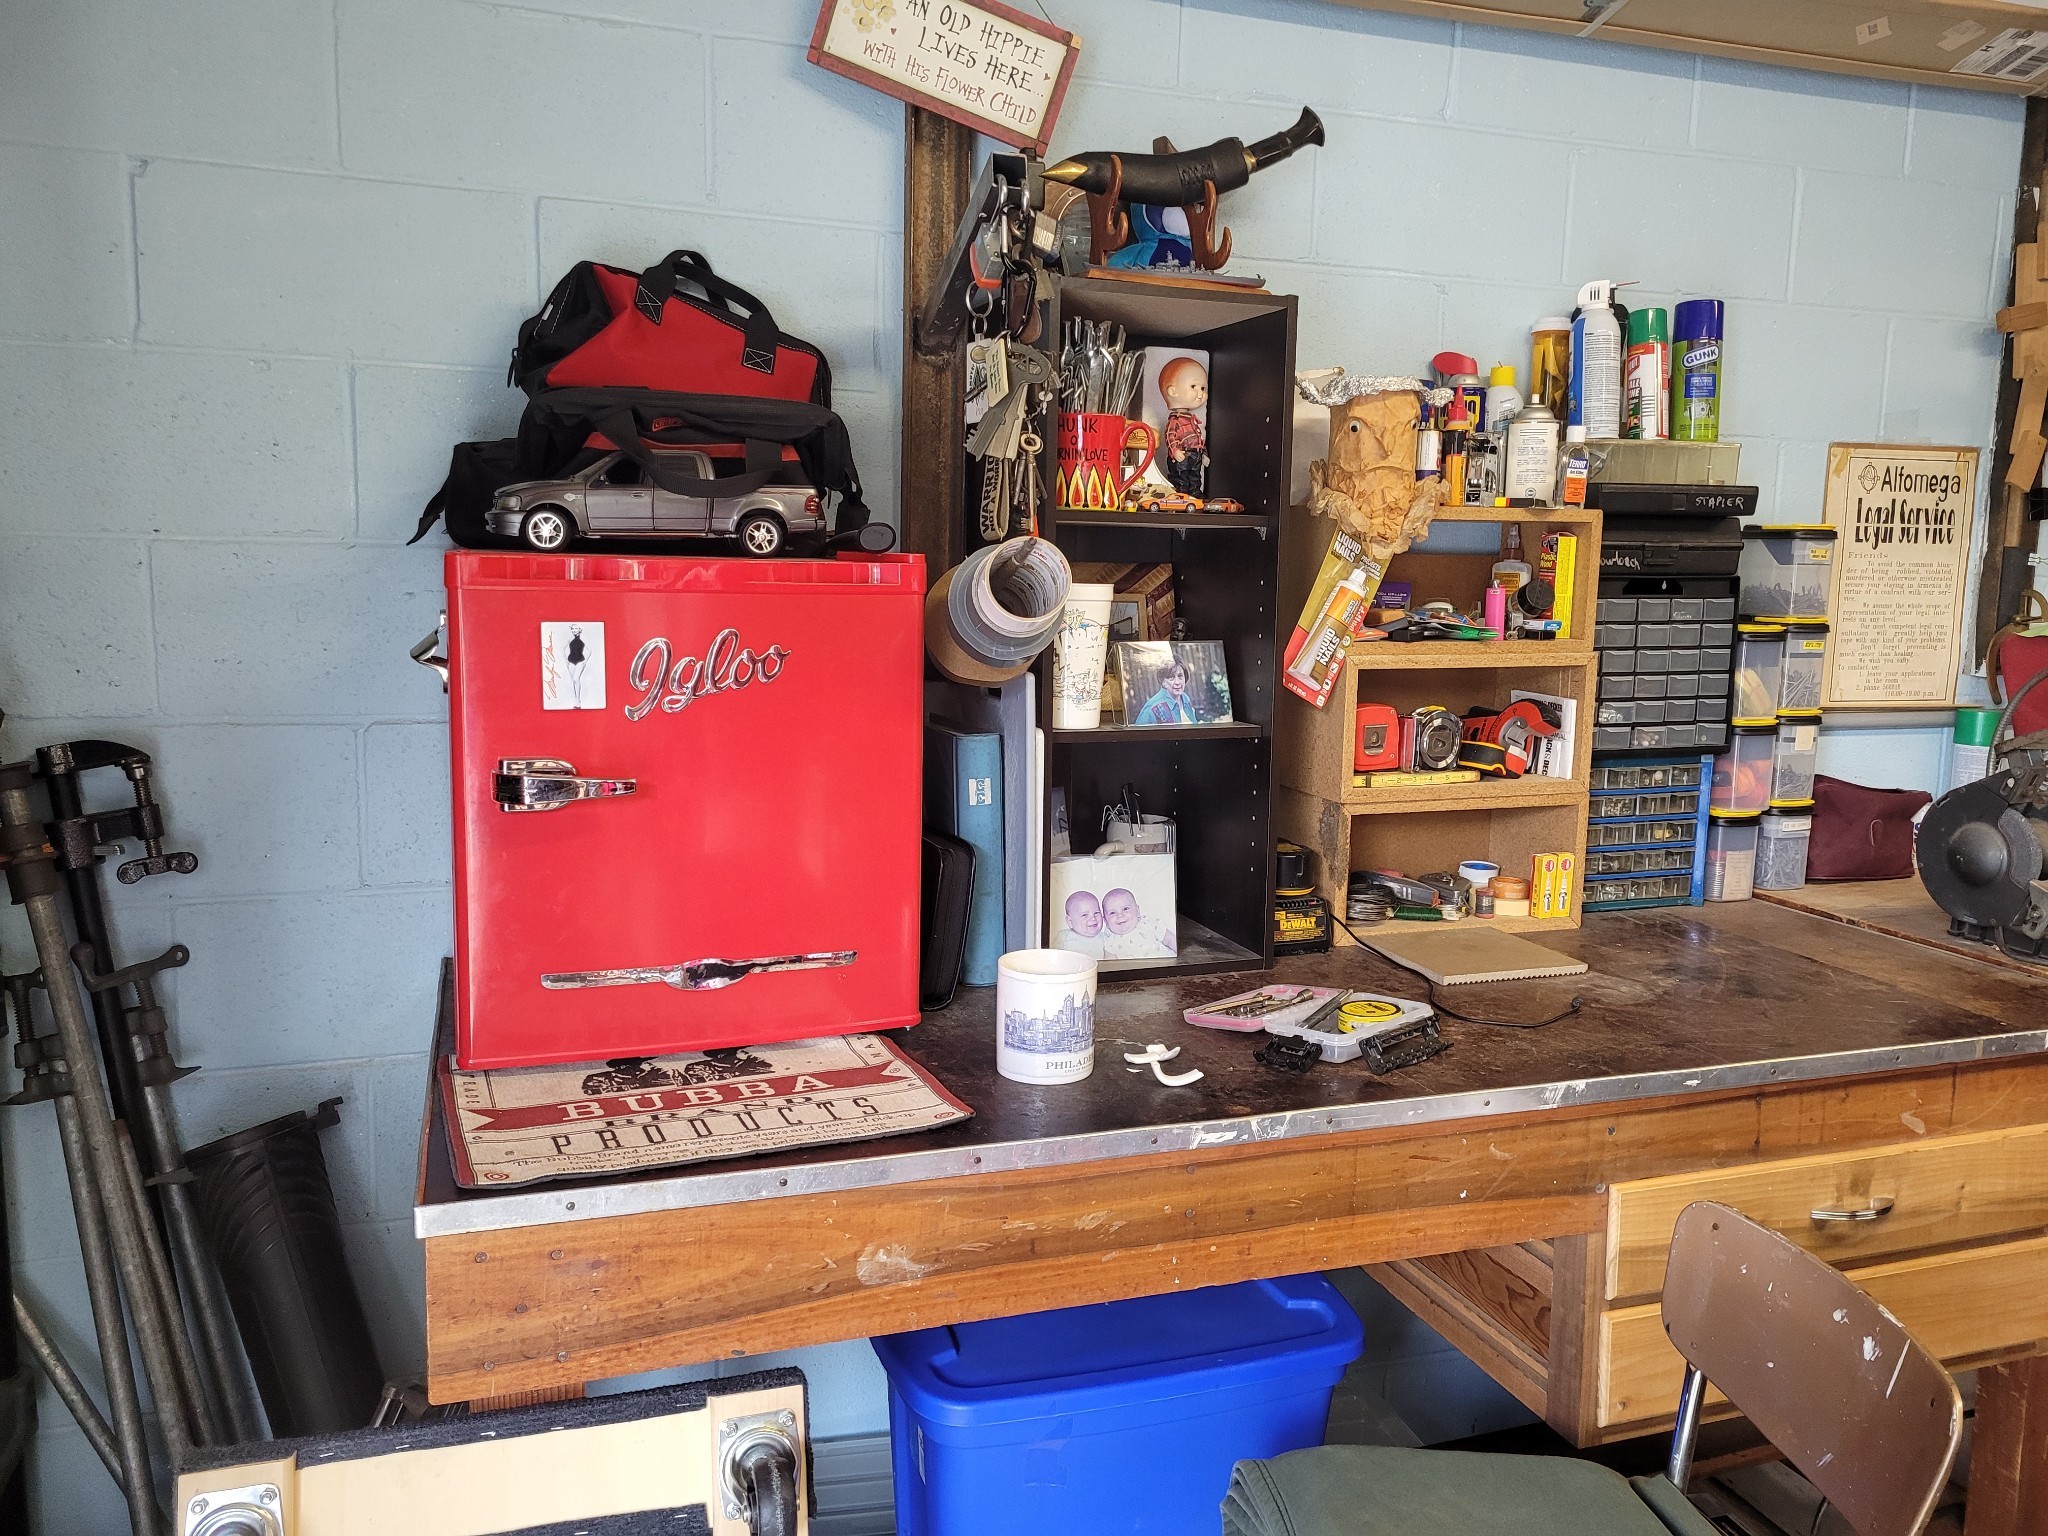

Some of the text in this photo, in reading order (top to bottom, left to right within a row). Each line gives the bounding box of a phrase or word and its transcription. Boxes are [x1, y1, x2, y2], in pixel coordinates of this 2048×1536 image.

[906, 0, 1046, 68] AN OLD HIPPIE
[918, 27, 978, 68] LIVES
[864, 39, 1036, 125] WITH HIS FLOWER CHILD
[1686, 349, 1717, 363] GUNK
[992, 458, 1000, 492] WORR
[1569, 460, 1586, 468] TERRO
[982, 456, 994, 534] WARRIO
[1881, 466, 1960, 502] Alfomega
[1855, 498, 1955, 550] Legal Service
[1334, 540, 1356, 562] NAILS
[1337, 531, 1362, 554] LIQUID
[1320, 636, 1340, 665] NAILS
[624, 628, 791, 721] Igloo
[1542, 760, 1550, 775] DEC
[1046, 1053, 1094, 1069] PHILADE
[558, 1075, 834, 1121] BUBBA
[551, 1097, 879, 1154] PRODUCTS
[597, 1150, 639, 1158] Brand
[684, 1134, 751, 1146] represents
[754, 1130, 788, 1138] years
[818, 1122, 852, 1130] years
